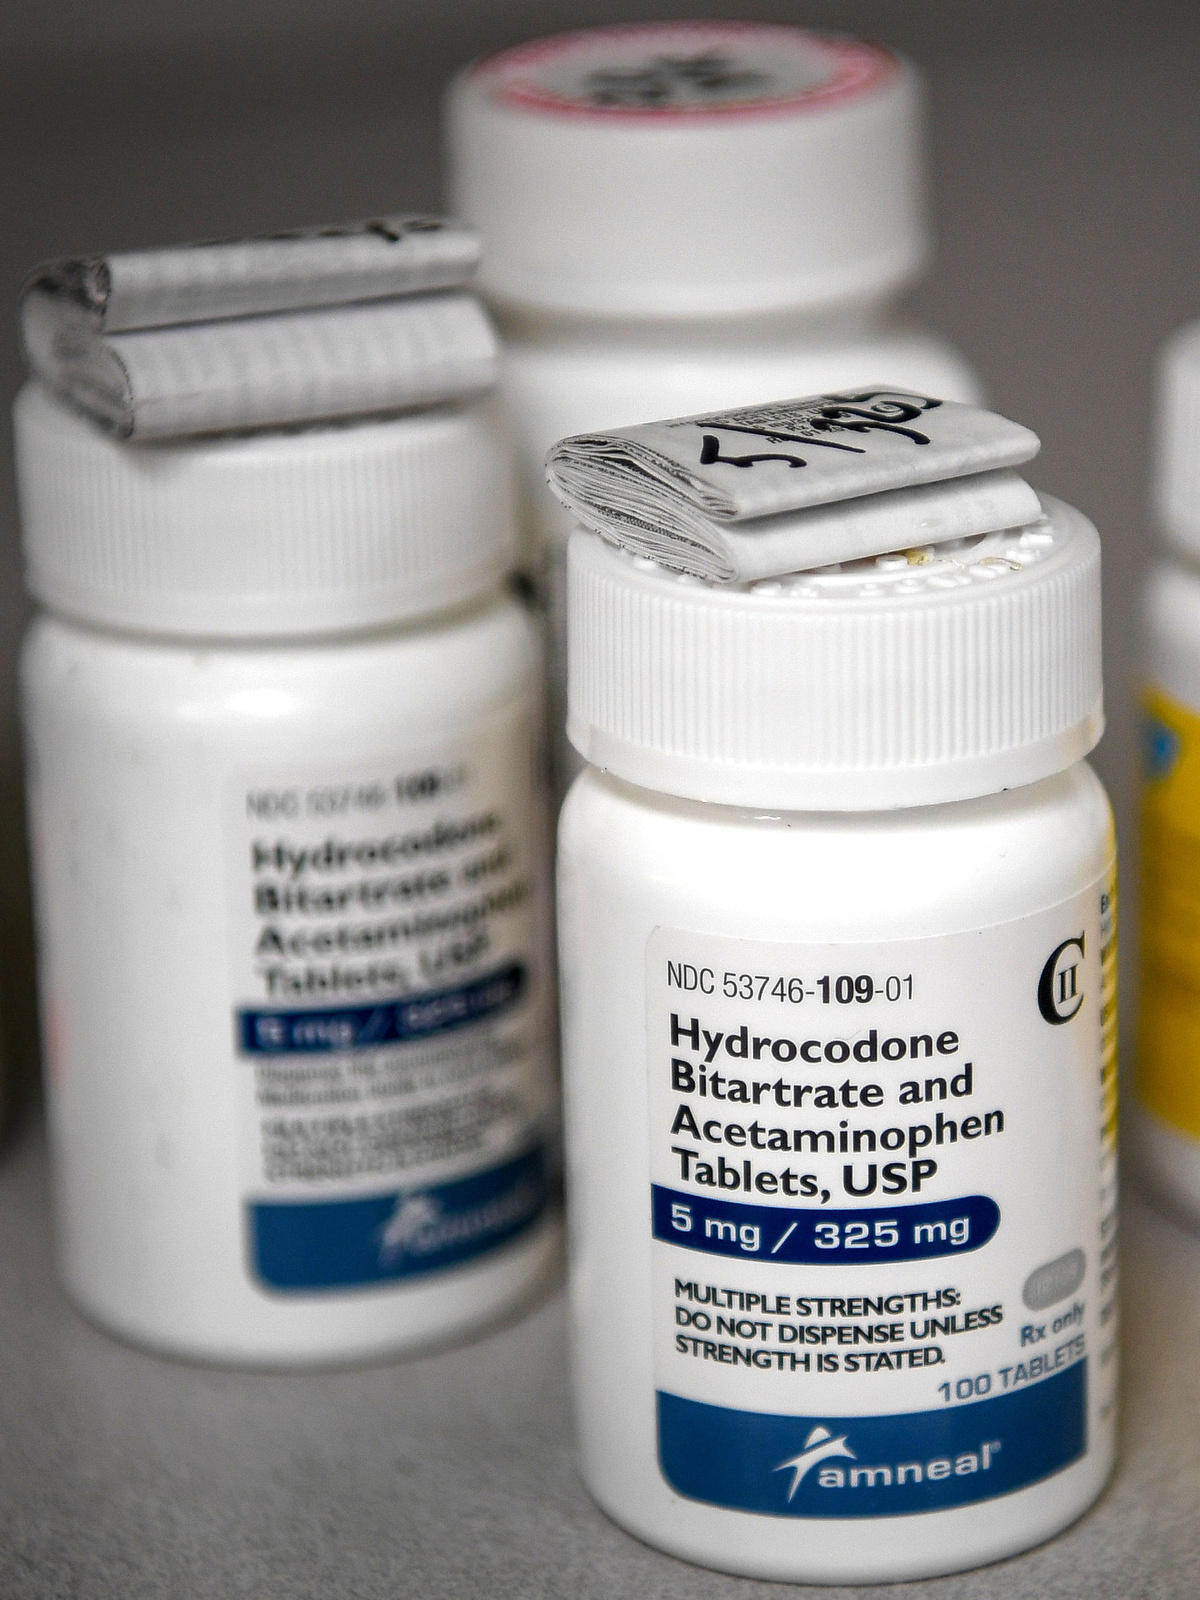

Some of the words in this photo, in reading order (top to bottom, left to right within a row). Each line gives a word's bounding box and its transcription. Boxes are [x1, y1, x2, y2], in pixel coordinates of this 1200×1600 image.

[667, 960, 715, 994] NDC
[722, 972, 914, 1004] 53746-109-01
[669, 1013, 959, 1064] Hydrocodone
[671, 1057, 885, 1108] Bitartrate
[899, 1062, 974, 1102] and
[671, 1104, 1005, 1158] Acetaminophen
[671, 1146, 831, 1204] Tablets,
[842, 1158, 938, 1197] USP
[671, 1202, 693, 1233] 5
[705, 1215, 761, 1253] mg
[771, 1222, 798, 1254] /
[814, 1220, 899, 1250] 325
[913, 1215, 970, 1246] mg
[674, 1277, 791, 1316] MULTIPLE
[796, 1287, 961, 1318] STRENGTHS:
[675, 1305, 711, 1333] DO
[716, 1315, 770, 1343] NOT
[777, 1321, 904, 1346] DISPENSE
[909, 1304, 1003, 1341] UNLESS
[1020, 1324, 1046, 1348] Rx
[1052, 1302, 1085, 1335] only
[675, 1334, 811, 1372] STRENGTH
[816, 1352, 839, 1373] IS
[843, 1345, 945, 1373] STATED.
[937, 1372, 992, 1403] 100
[998, 1334, 1086, 1388] TABLETS
[818, 1443, 991, 1488] amneal
